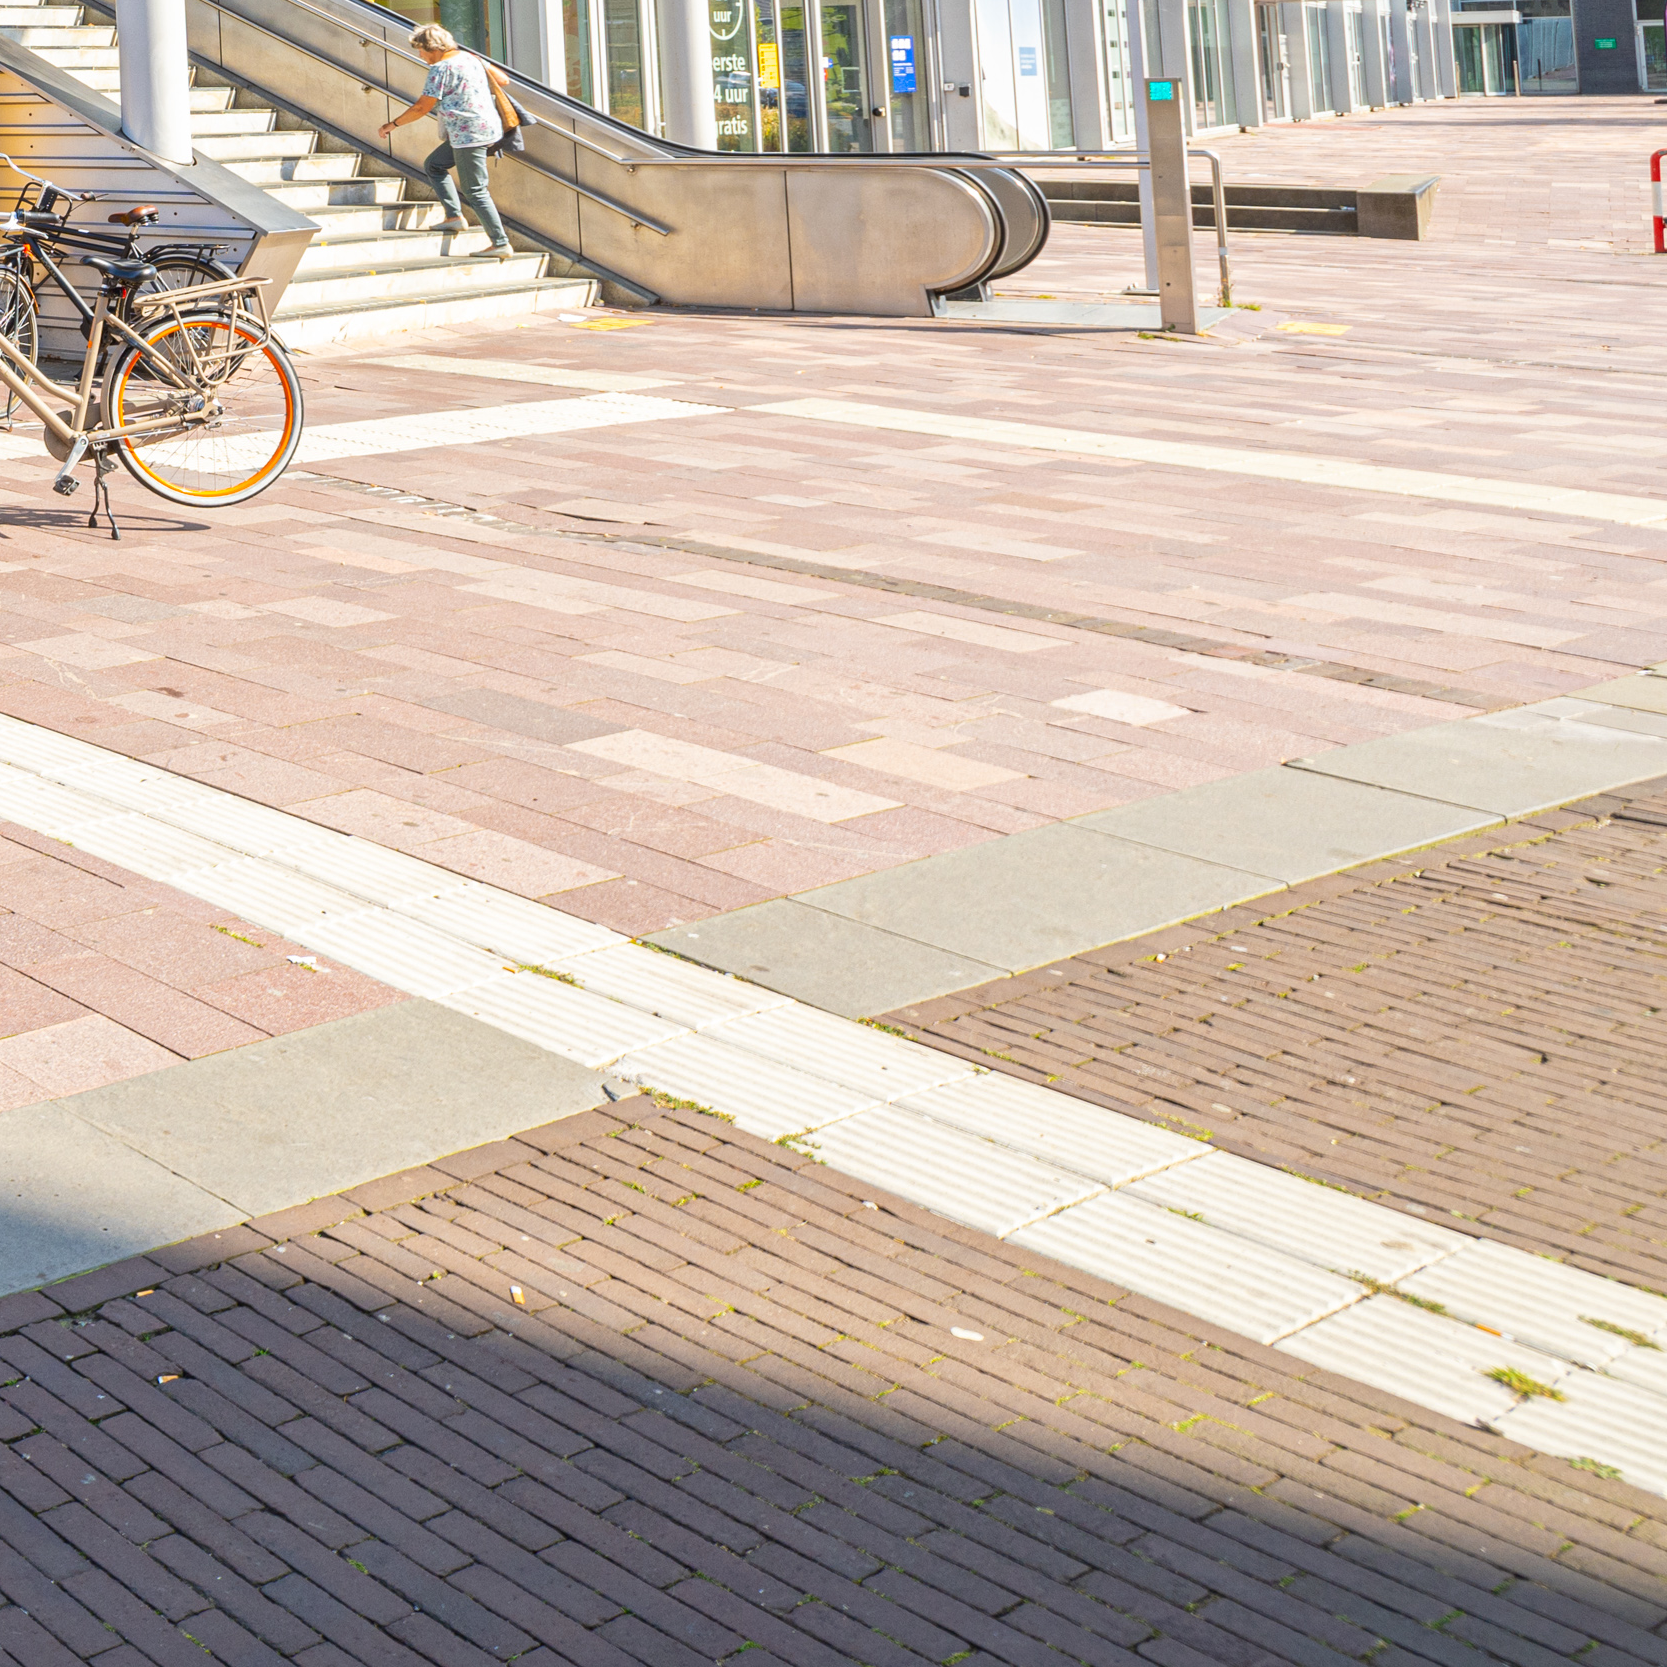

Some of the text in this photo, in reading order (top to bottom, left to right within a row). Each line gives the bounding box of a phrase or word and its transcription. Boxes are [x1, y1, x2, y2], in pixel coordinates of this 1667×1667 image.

[713, 10, 732, 23] uur
[712, 53, 746, 72] erste
[725, 87, 749, 103] uur
[716, 115, 748, 139] ratis
